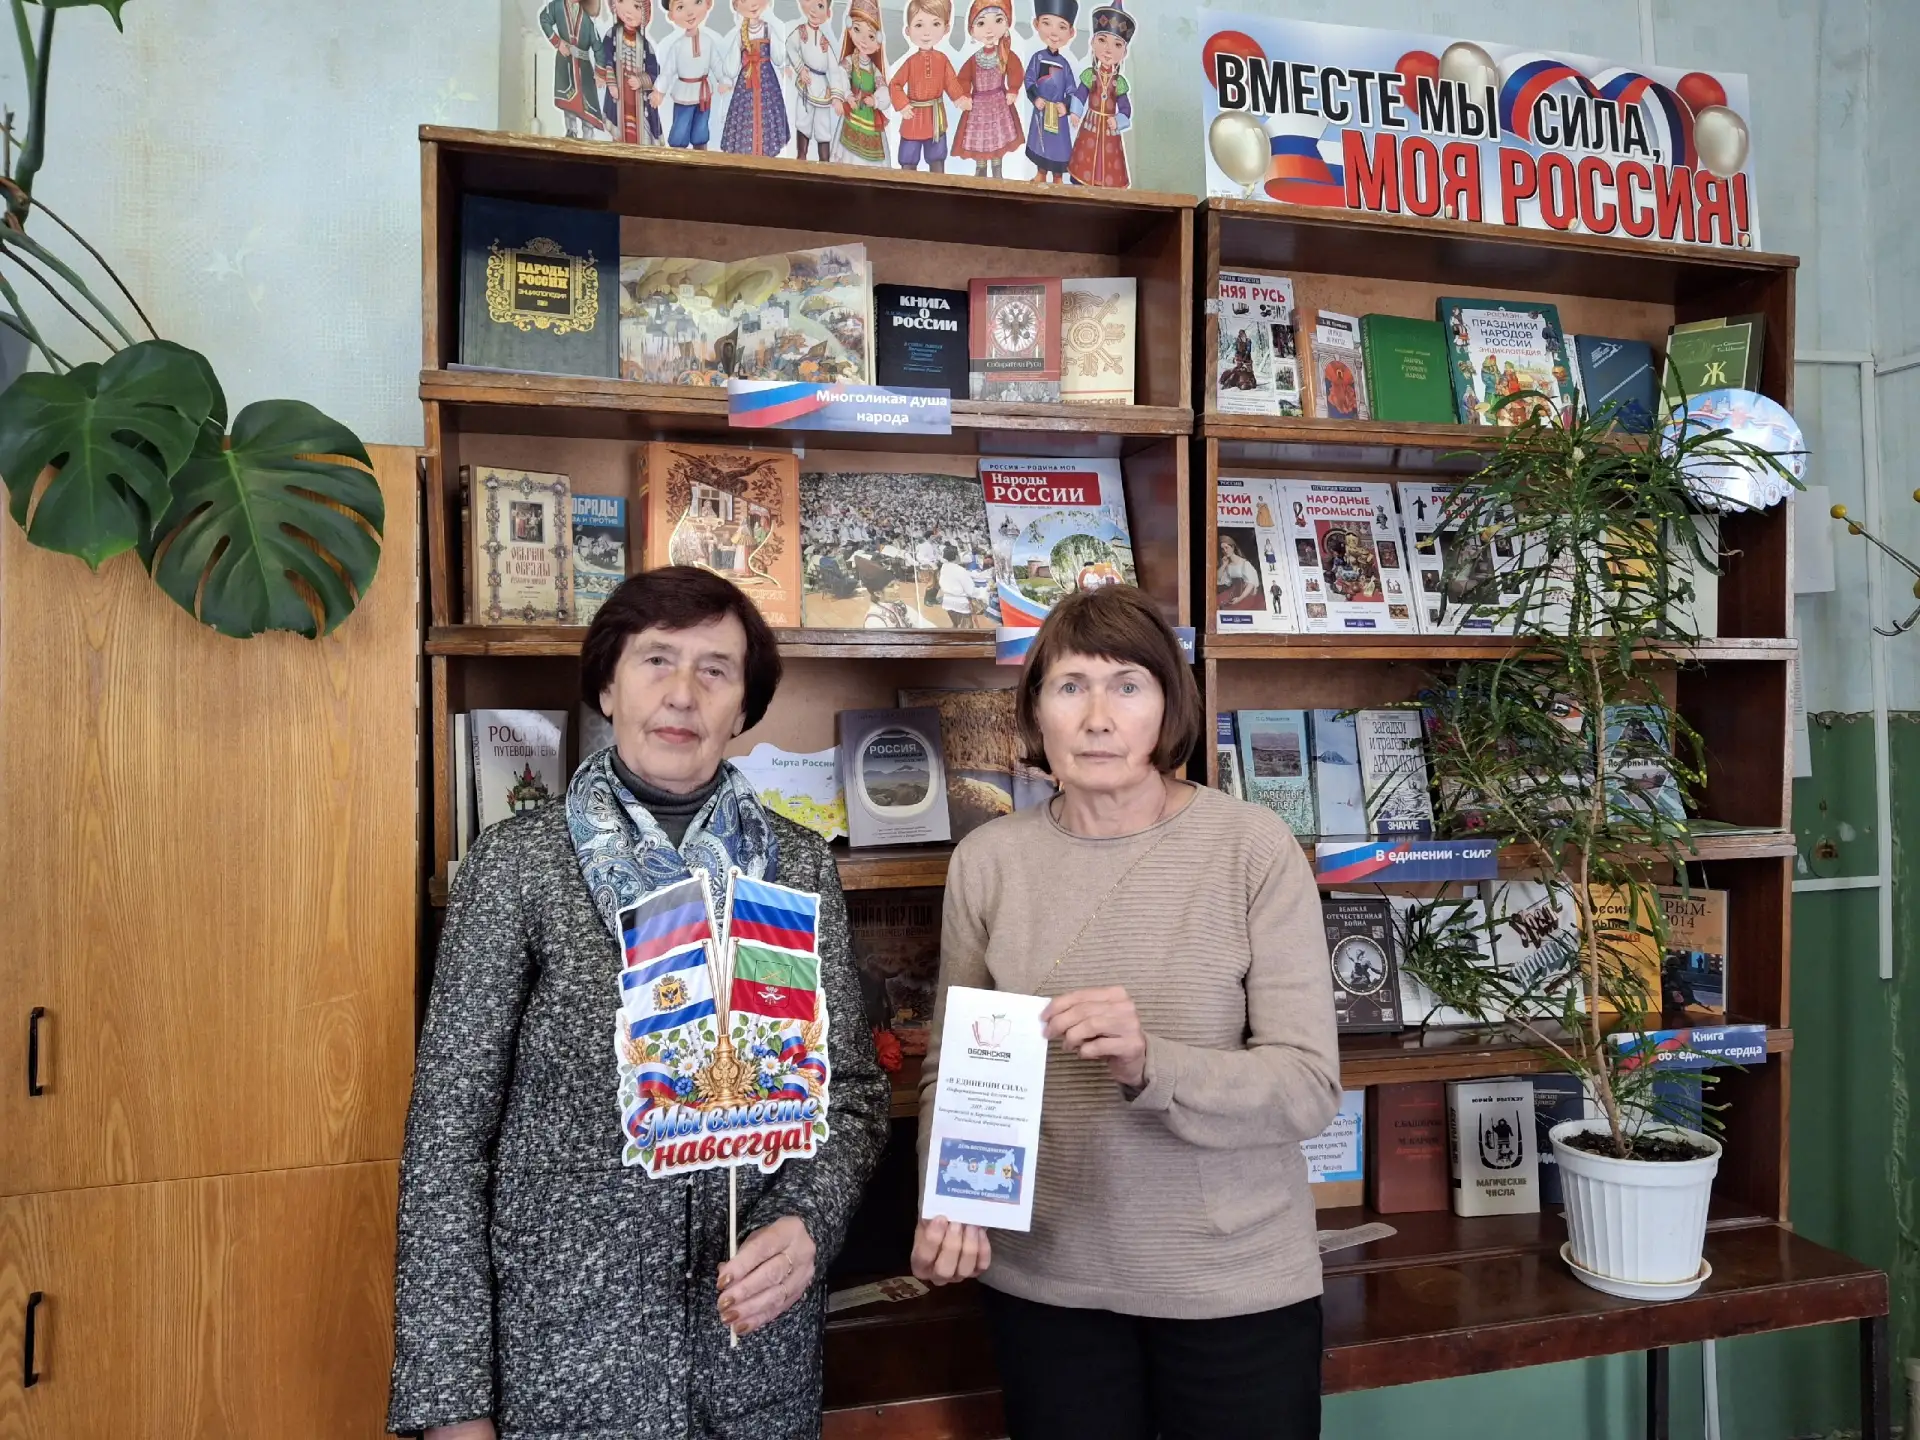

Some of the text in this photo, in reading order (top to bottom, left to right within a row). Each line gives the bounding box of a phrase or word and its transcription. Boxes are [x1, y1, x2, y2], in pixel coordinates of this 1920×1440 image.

[1215, 53, 1664, 163] ВМЕСТЕ МЫ СИЛА,
[1342, 130, 1750, 248] МОЯ РОССИЯ!
[517, 261, 570, 278] НАРОДЫ
[518, 273, 568, 289] РОССИИ
[1252, 287, 1286, 303] РУСЬ
[900, 295, 951, 310] КНИГА
[919, 308, 930, 319] О
[892, 315, 958, 332] РОССИИ
[1472, 319, 1538, 331] ПРАЗДНИКИ
[1480, 329, 1533, 339] НАРОДОВ
[1485, 338, 1532, 348] РОССИИ
[816, 390, 947, 408] Многоликая душа
[856, 412, 909, 425] народа
[991, 473, 1047, 486] Народы
[992, 486, 1085, 503] РОССИИ
[1306, 494, 1371, 506] НАРОДНЫЕ
[571, 497, 618, 517] ОБРЯДЫ
[1306, 506, 1375, 517] ПРОМЫСЛЫ
[494, 745, 557, 758] ПУТЕВОДИТЕЛЬ
[771, 757, 835, 769] Карта России
[1387, 820, 1420, 830] ЗНАНИЕ
[1375, 849, 1385, 862] В
[1388, 849, 1453, 864] единении
[1338, 905, 1368, 913] ВЕЛИКАЯ
[1662, 900, 1712, 917] РЫМ-
[1692, 1032, 1725, 1043] Книга
[1724, 1045, 1763, 1059] сердца
[636, 1096, 819, 1149] Мы вместе
[653, 1123, 814, 1172] навсегда!
[1476, 1177, 1527, 1187] МАГИЧЕСКИЕ
[1485, 1189, 1516, 1198] ЧИСЛА
